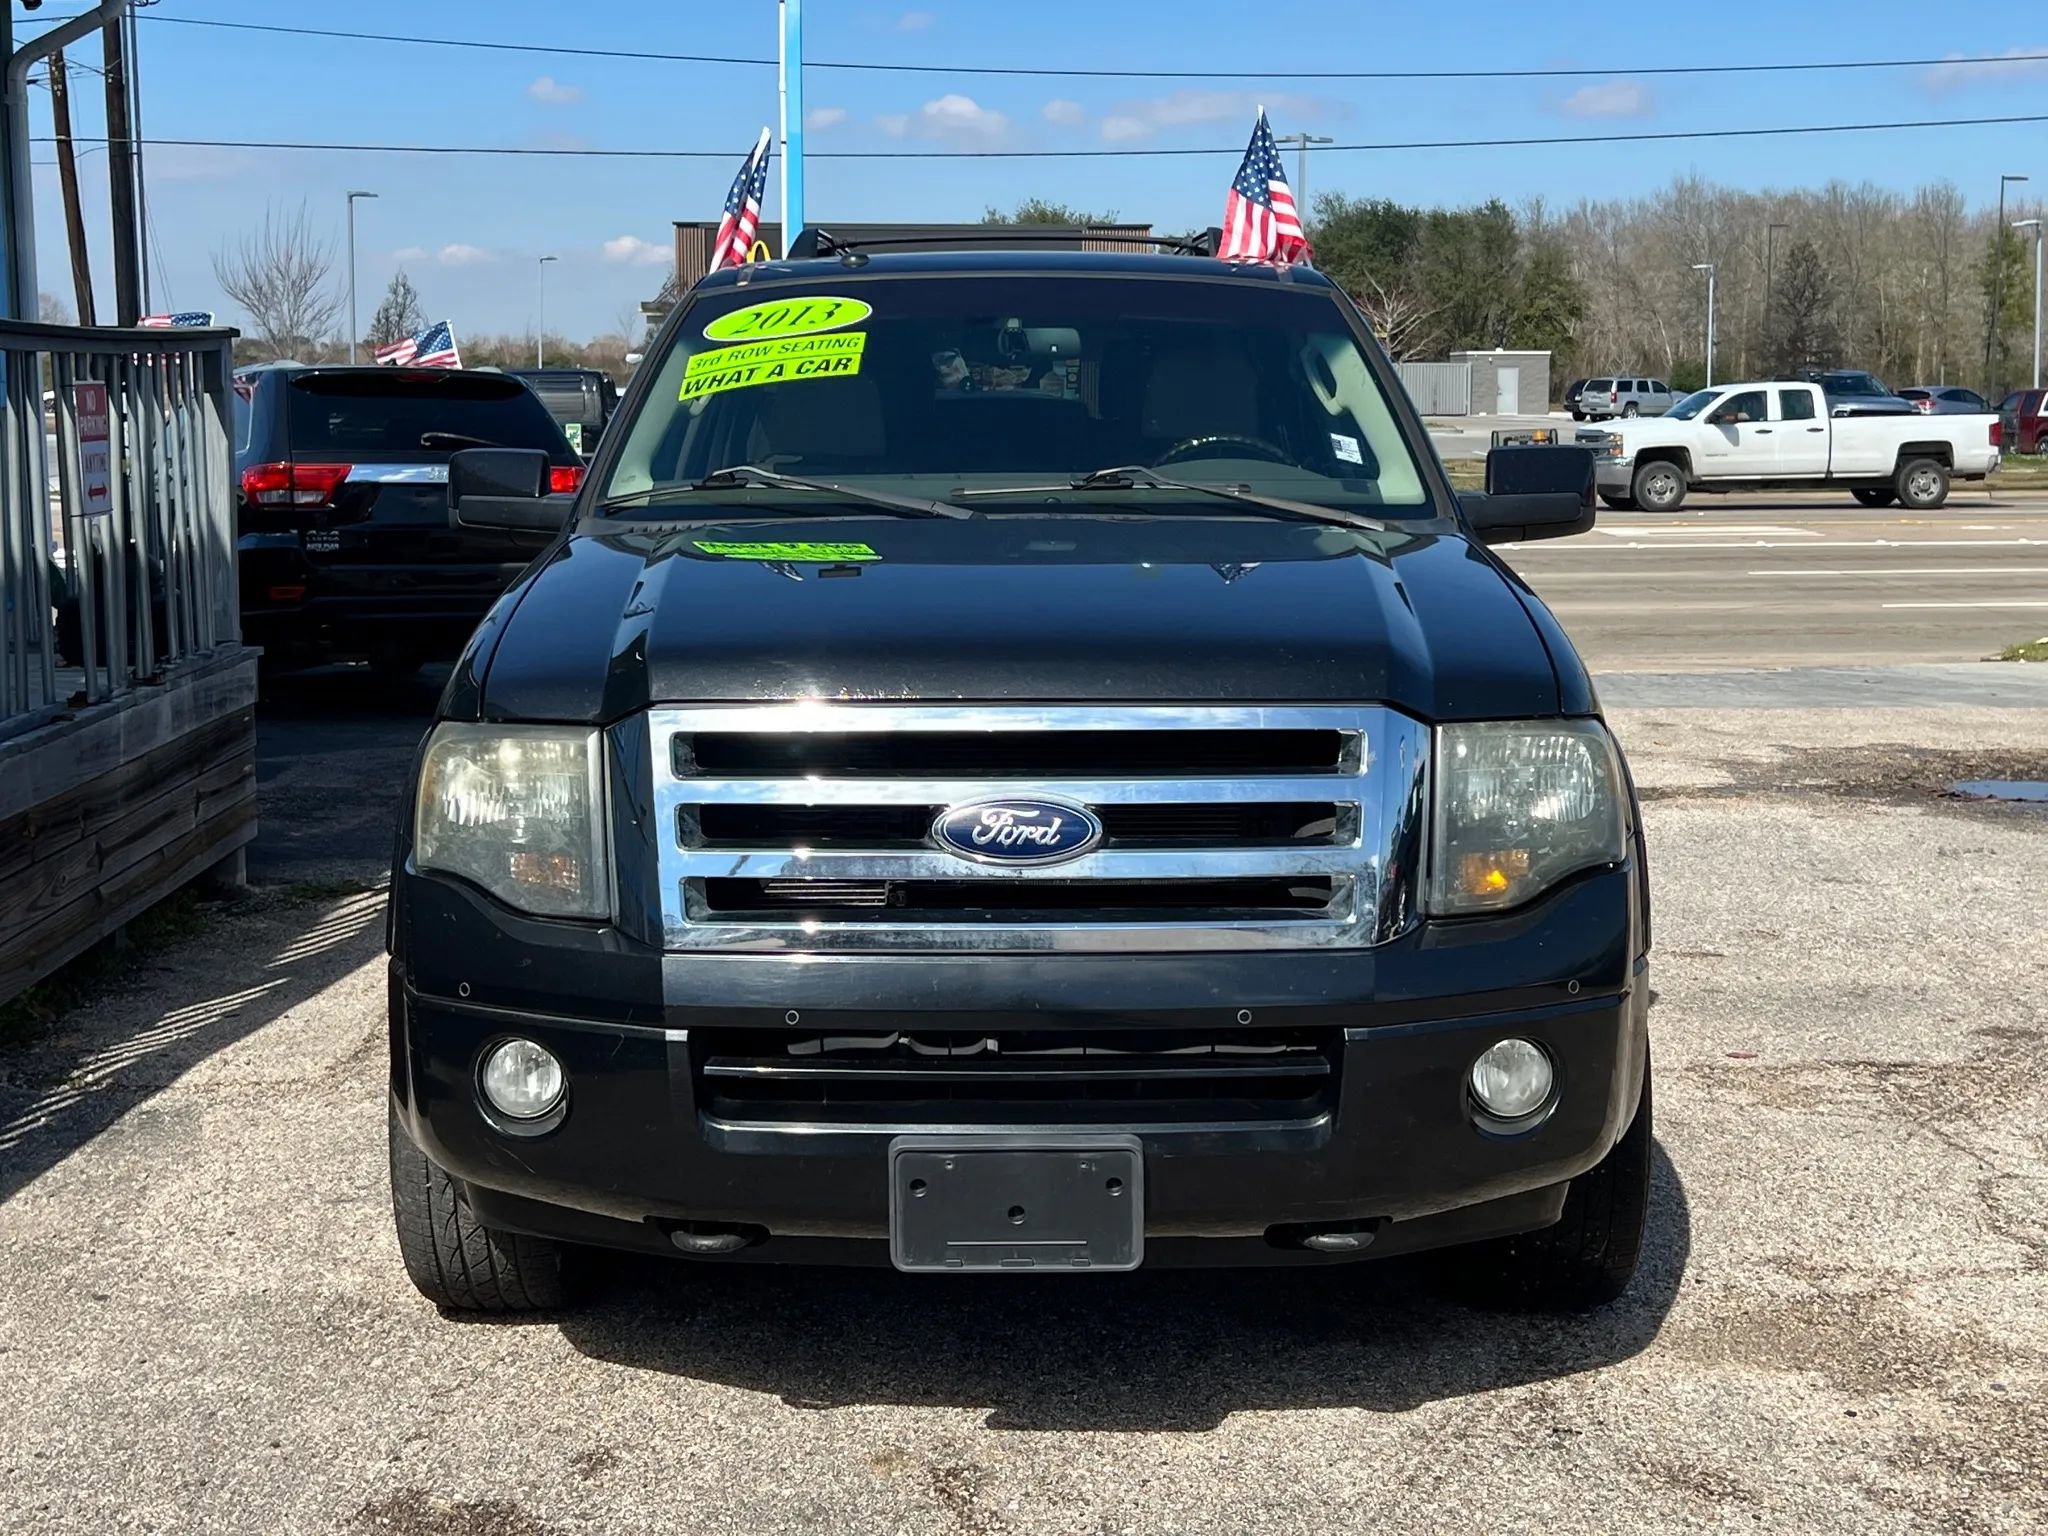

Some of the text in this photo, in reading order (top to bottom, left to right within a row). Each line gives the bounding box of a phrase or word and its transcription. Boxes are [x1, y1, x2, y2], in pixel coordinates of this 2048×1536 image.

[729, 303, 842, 335] 2013
[691, 338, 861, 370] 3rd ROW SEATING
[684, 357, 853, 395] WHAT A CAR
[972, 807, 1062, 846] Ford
